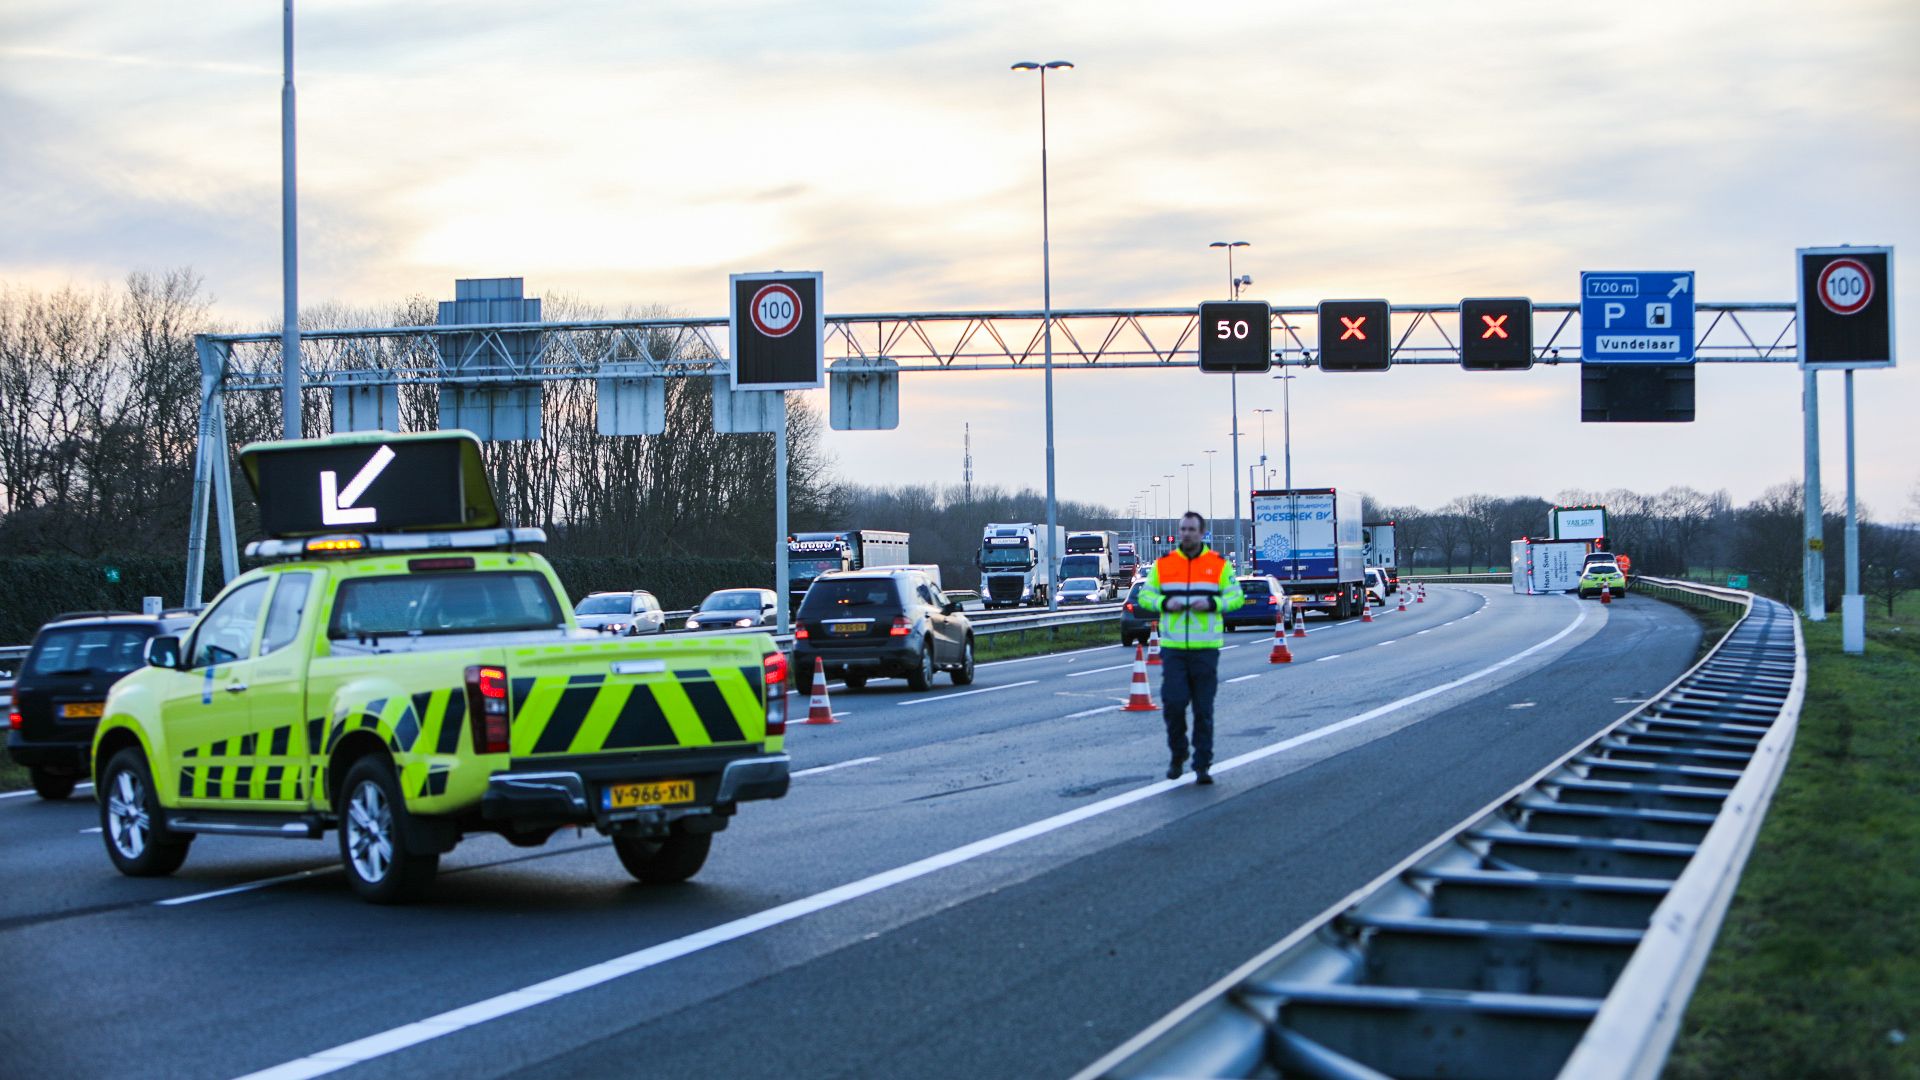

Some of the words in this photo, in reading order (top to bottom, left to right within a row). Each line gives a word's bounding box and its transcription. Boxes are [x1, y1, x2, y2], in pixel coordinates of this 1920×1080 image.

[1592, 282, 1619, 293] 700
[1621, 284, 1634, 293] m
[1829, 277, 1861, 296] 100
[761, 301, 791, 319] 100
[1604, 303, 1626, 329] P
[1217, 320, 1249, 340] 50
[1601, 339, 1675, 349] Vundelaar
[1316, 511, 1331, 520] BV
[614, 782, 690, 804] V-966-XN
